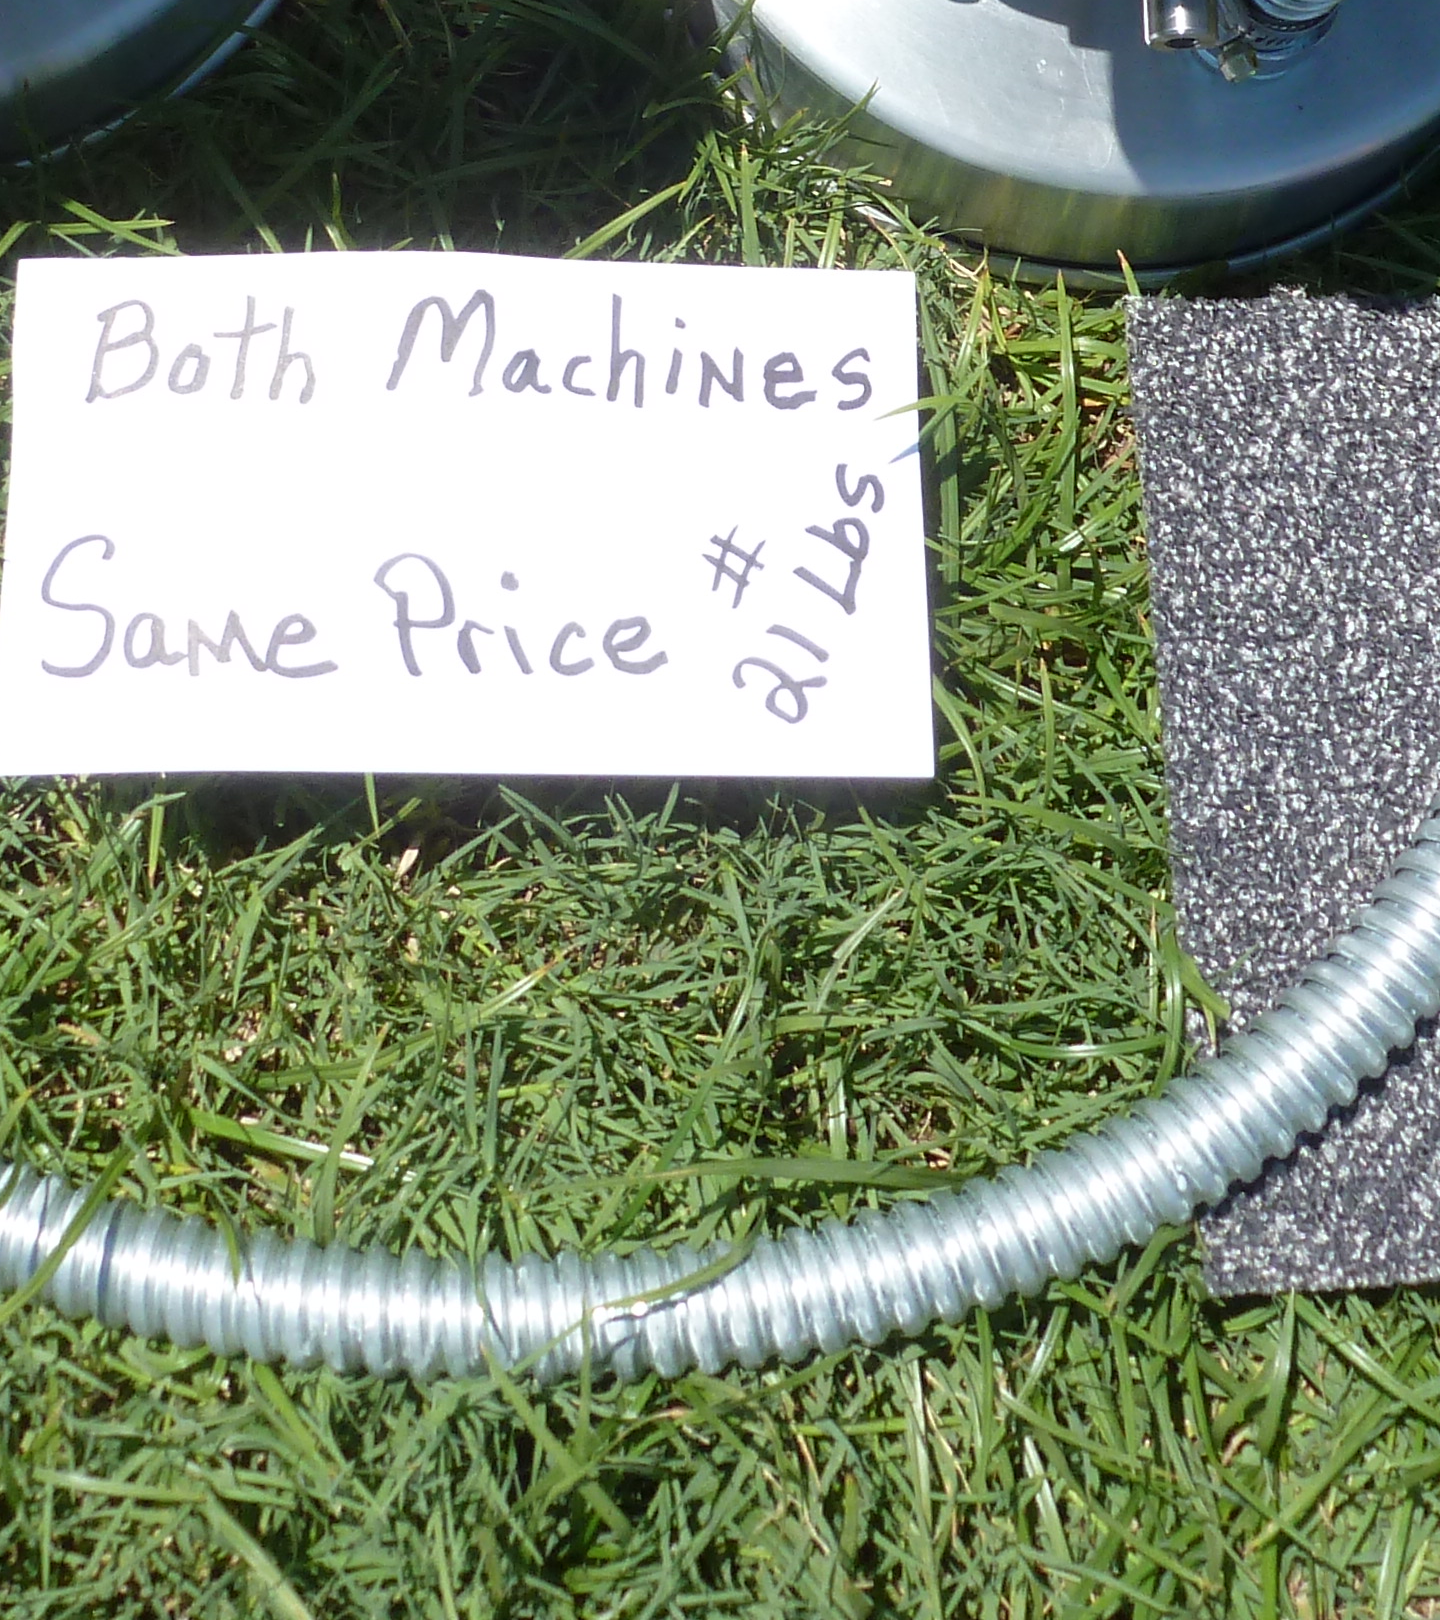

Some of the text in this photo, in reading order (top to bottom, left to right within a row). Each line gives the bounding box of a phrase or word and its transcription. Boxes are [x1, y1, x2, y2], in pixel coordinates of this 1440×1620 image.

[86, 296, 318, 404] Both
[373, 551, 669, 676] Price
[702, 524, 766, 609] #
[732, 623, 829, 724] 21
